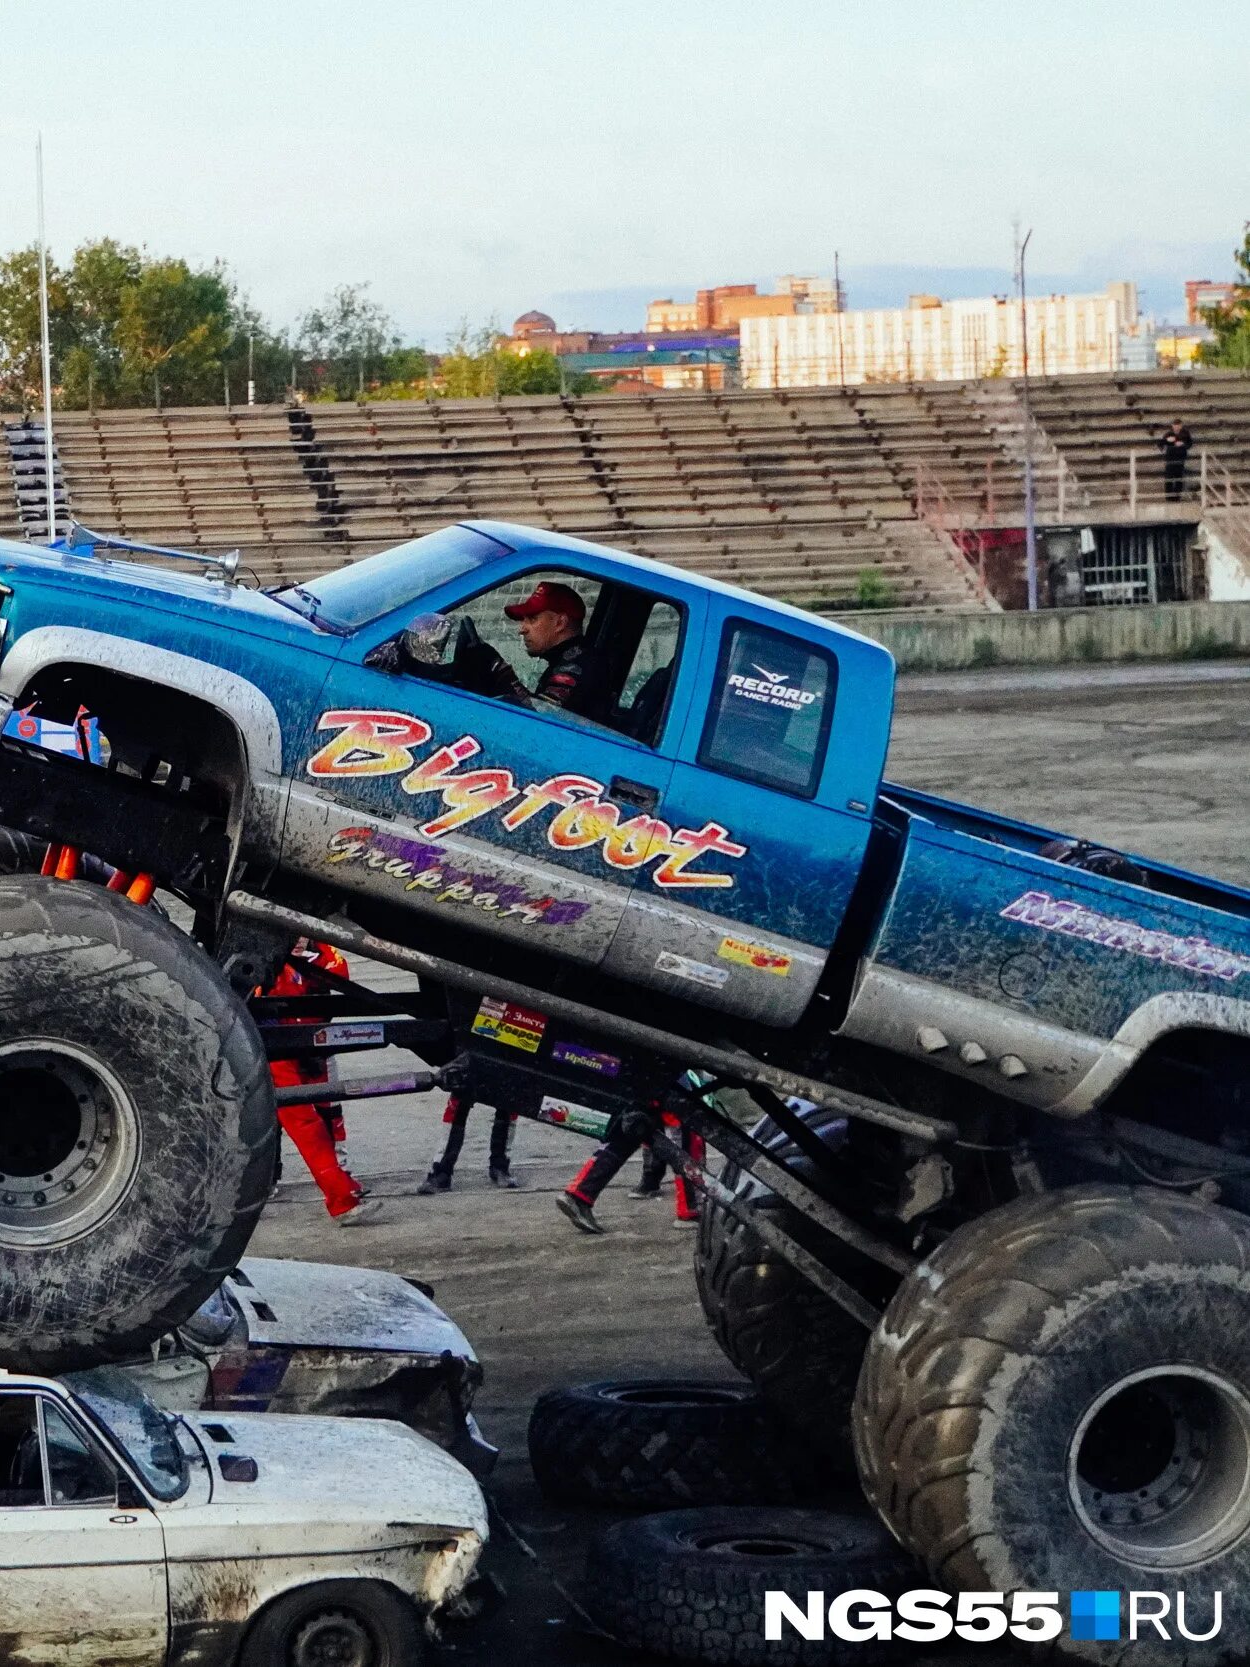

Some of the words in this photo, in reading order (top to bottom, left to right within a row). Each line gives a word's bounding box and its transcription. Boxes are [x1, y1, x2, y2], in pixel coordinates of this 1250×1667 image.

[728, 674, 815, 705] RECORD
[735, 689, 770, 703] DANCE
[770, 696, 802, 710] RADIO
[306, 709, 747, 887] Bigfoot
